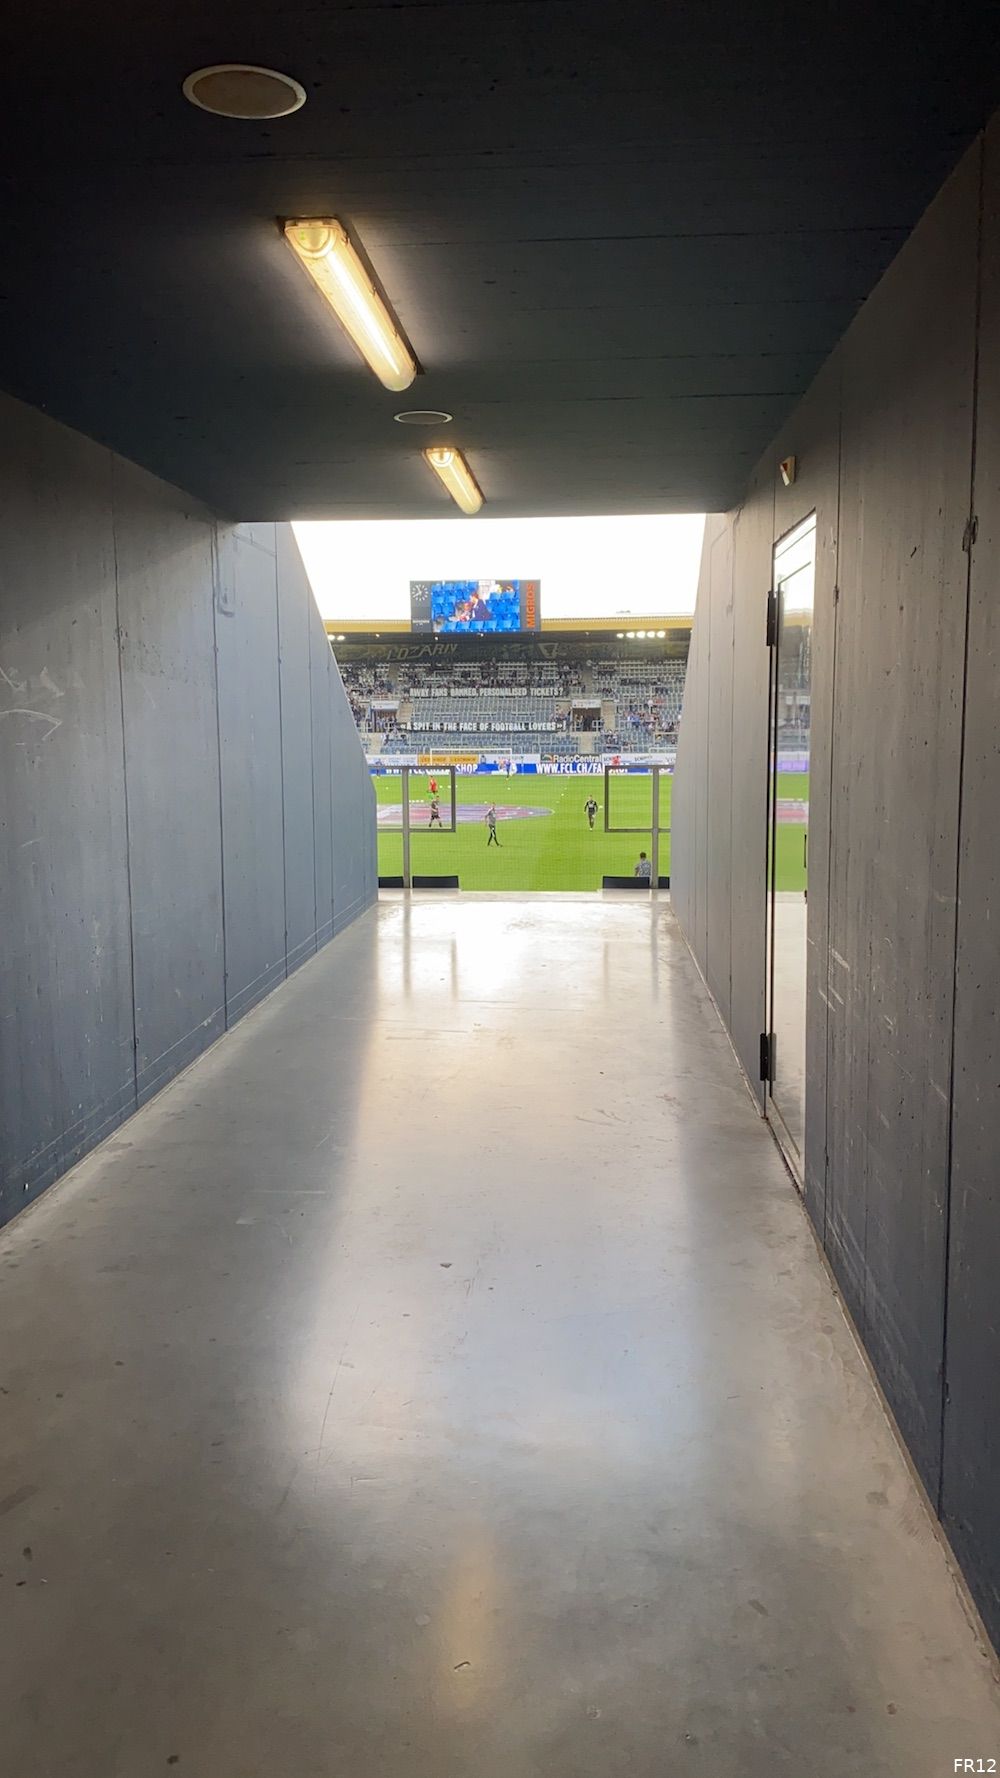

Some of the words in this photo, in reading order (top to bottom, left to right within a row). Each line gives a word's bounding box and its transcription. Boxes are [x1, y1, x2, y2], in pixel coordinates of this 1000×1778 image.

[526, 583, 535, 628] MIGROS
[409, 687, 430, 697] AWAY
[431, 687, 448, 697] FANS
[480, 687, 527, 697] PERSONALISED
[530, 687, 564, 696] TICKETS?
[413, 721, 430, 731] SPIT
[432, 721, 441, 731] IN
[443, 721, 457, 731] THE
[459, 721, 477, 731] FACE
[480, 721, 489, 731] OF
[491, 721, 525, 731] FOOTBALL
[553, 754, 601, 763] RadioCentral
